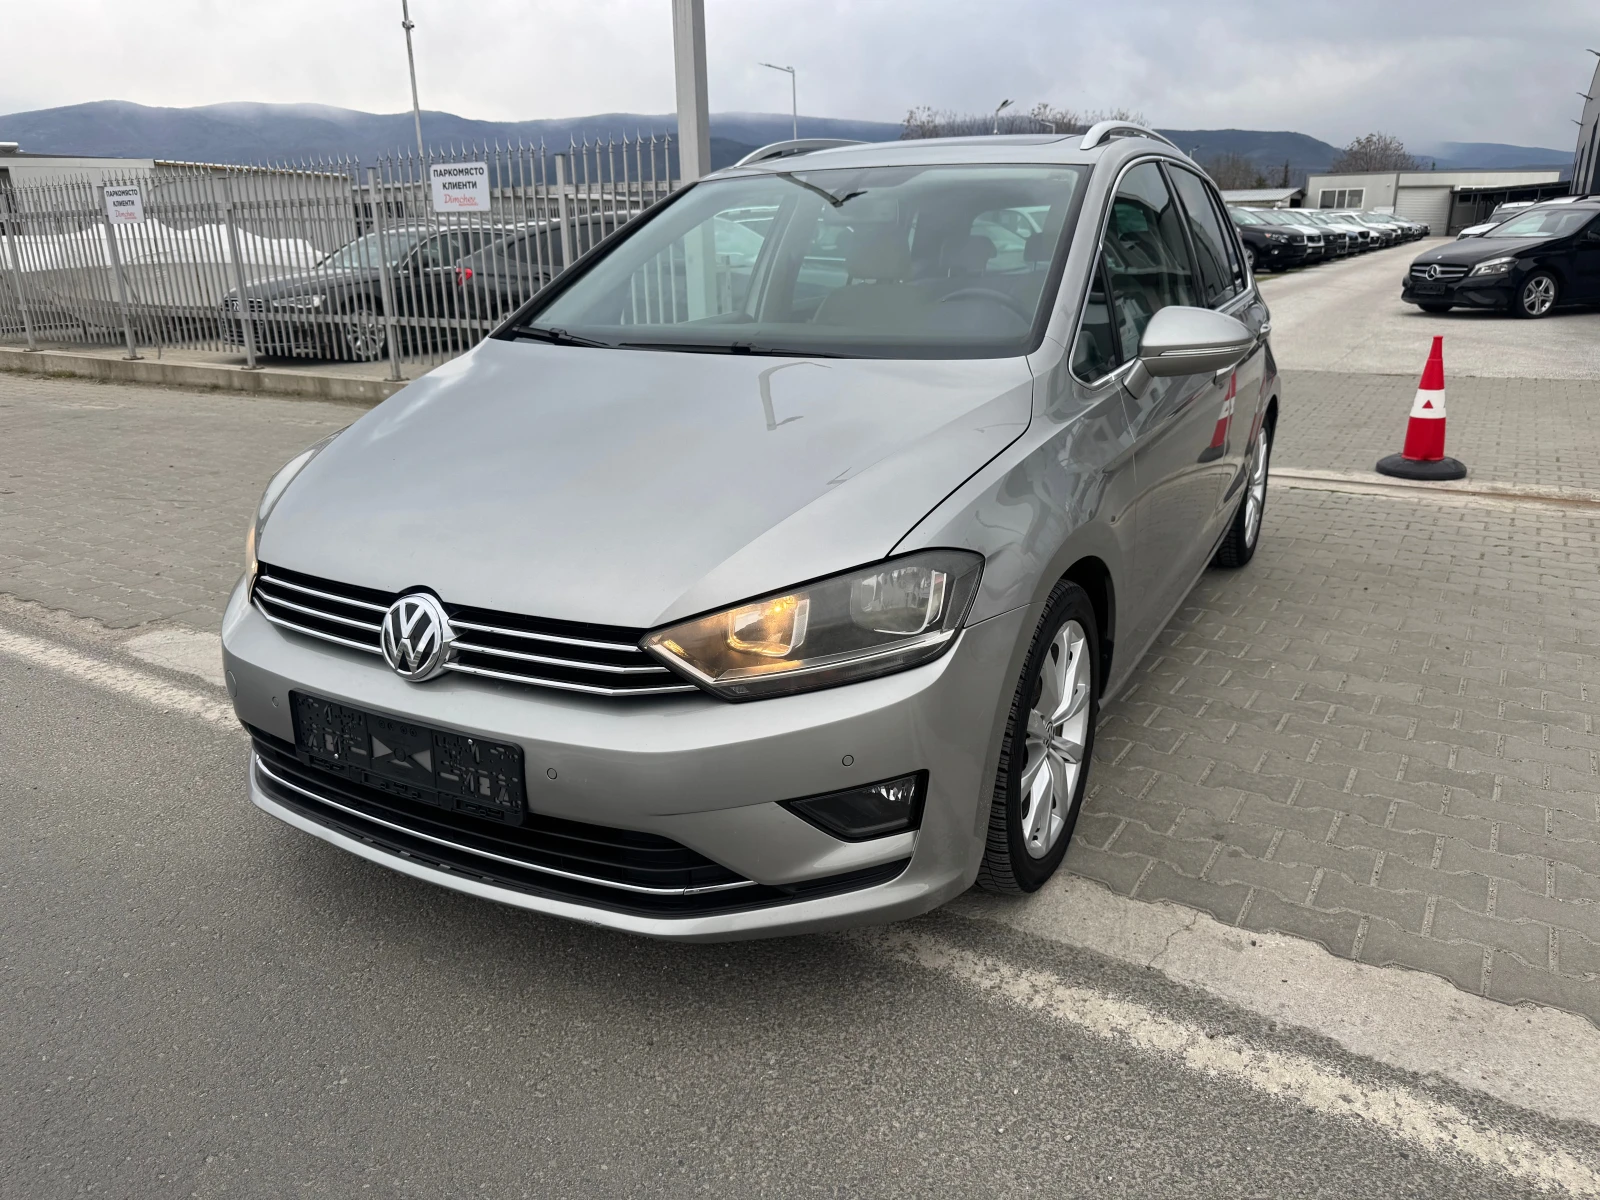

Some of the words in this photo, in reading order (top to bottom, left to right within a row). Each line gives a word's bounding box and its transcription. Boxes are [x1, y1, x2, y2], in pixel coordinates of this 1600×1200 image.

[433, 167, 485, 177] ПАРКОМЯСТО
[442, 181, 477, 190] КЛИЕНТИ
[105, 189, 138, 197] ПАРКОМЯСТО
[112, 199, 135, 207] КЛИЕНТИ
